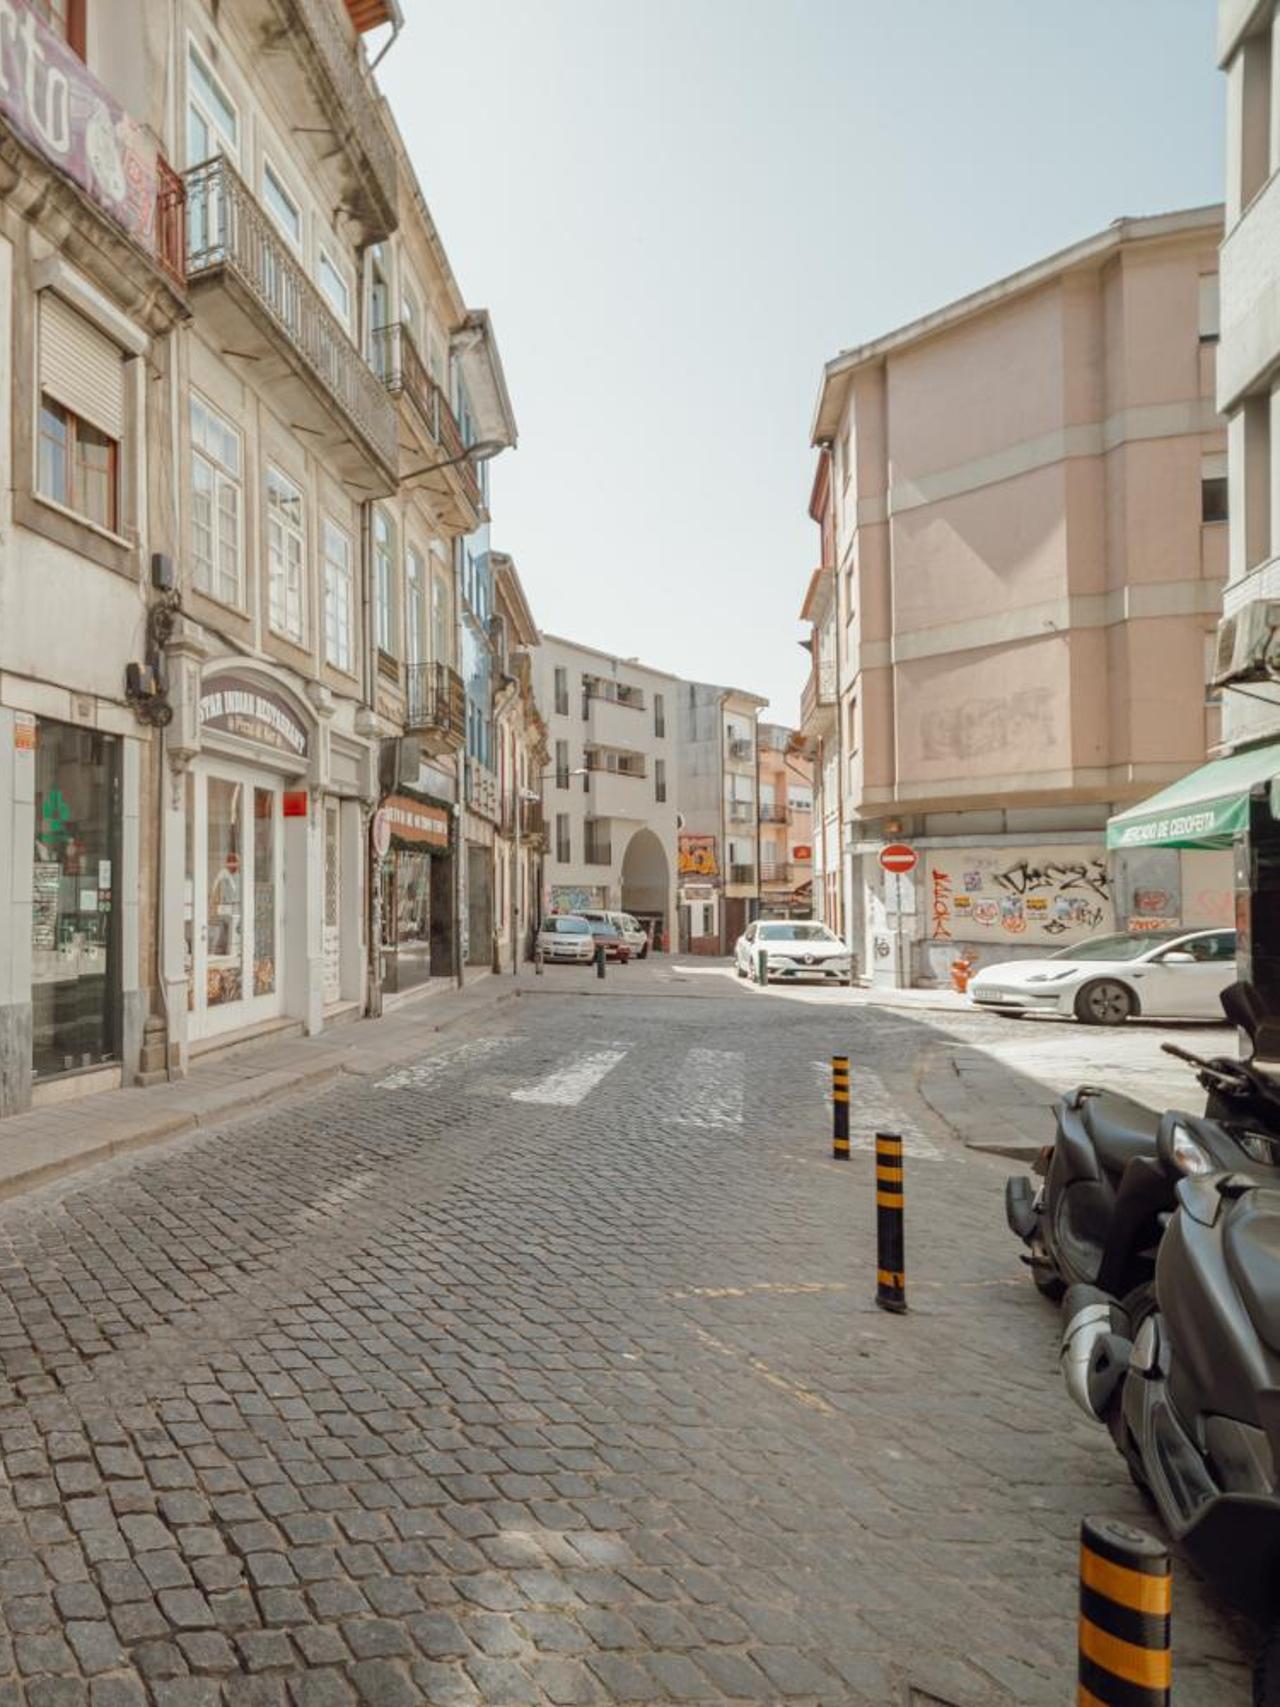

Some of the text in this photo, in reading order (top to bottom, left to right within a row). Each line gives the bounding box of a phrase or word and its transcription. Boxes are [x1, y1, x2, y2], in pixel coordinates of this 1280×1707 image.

[224, 690, 255, 716] INDIAN
[1158, 819, 1170, 839] DE
[1170, 811, 1216, 836] CEDOFEITA
